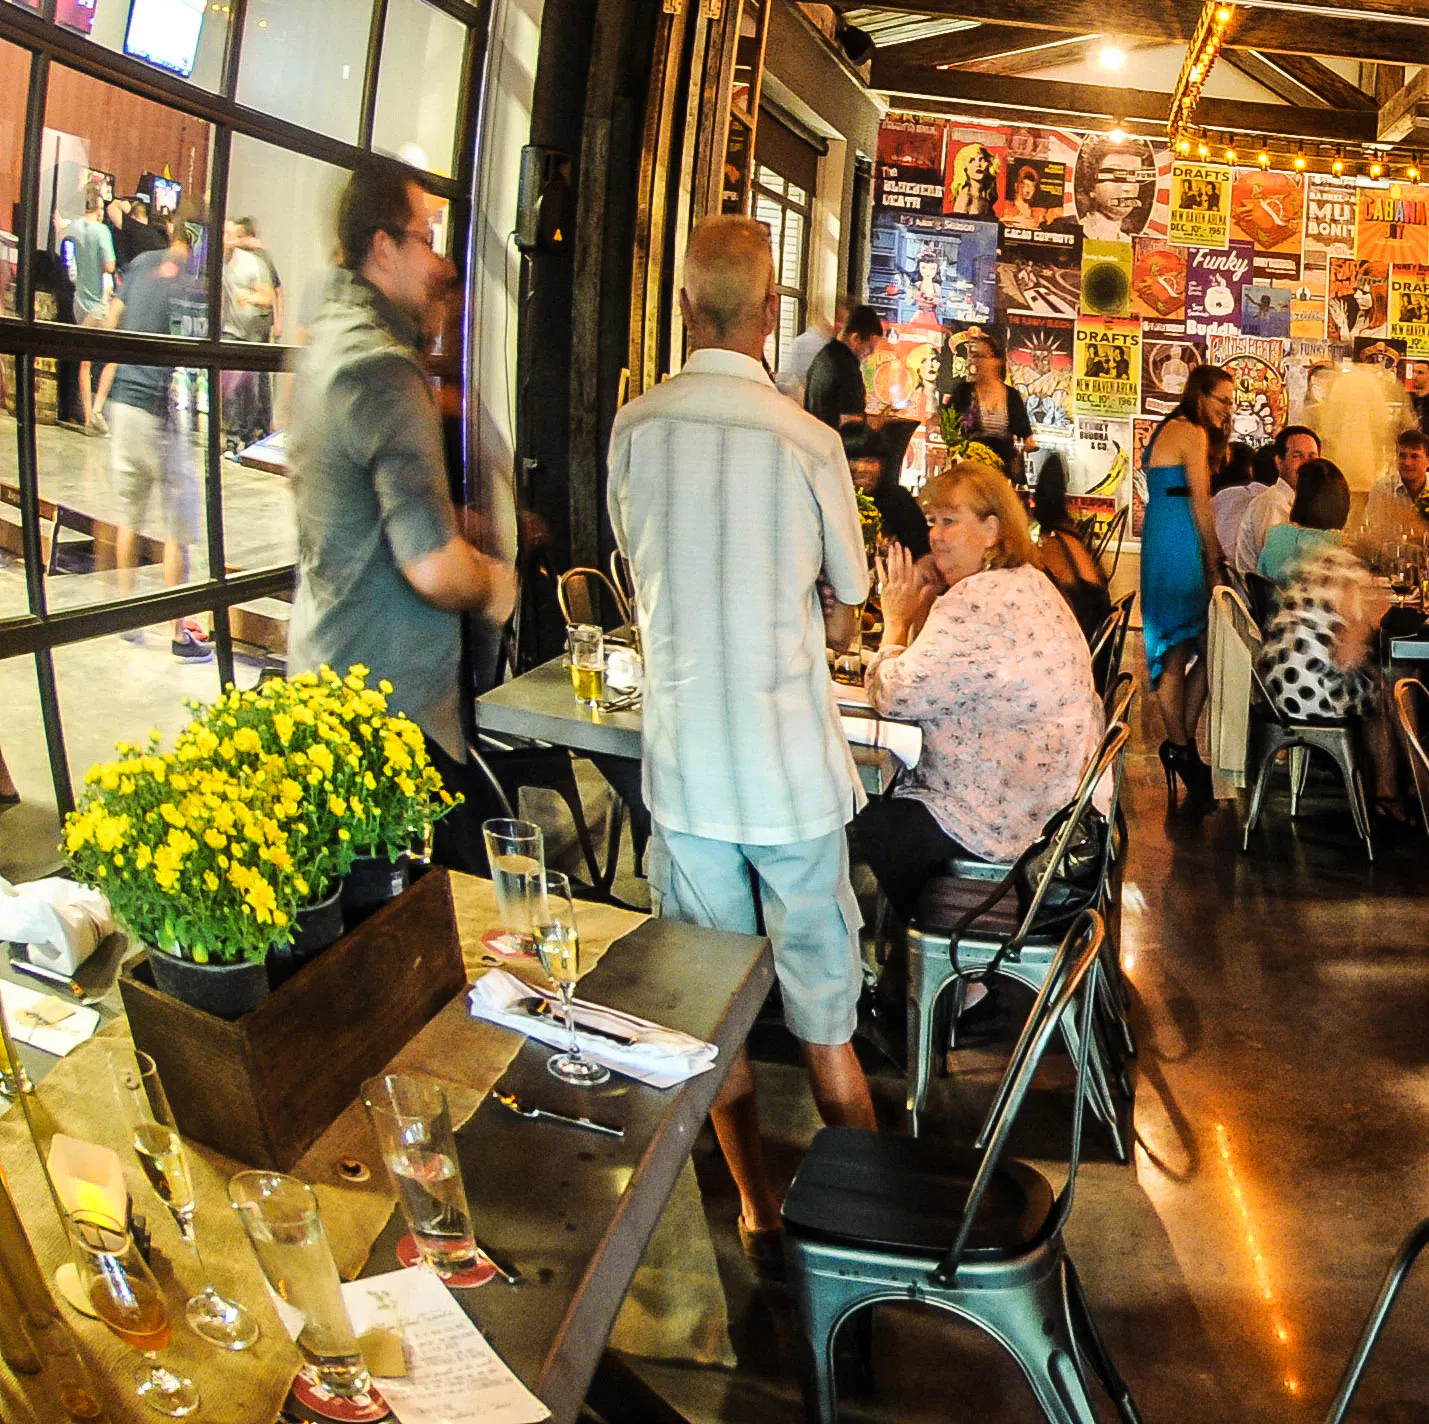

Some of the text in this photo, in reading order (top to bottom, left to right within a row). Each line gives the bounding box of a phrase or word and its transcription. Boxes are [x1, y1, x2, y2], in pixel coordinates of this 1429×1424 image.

[1173, 168, 1230, 181] DRAFTS
[1364, 197, 1427, 225] CABANA
[1193, 249, 1249, 281] Funky
[1186, 319, 1242, 335] Buddh
[1076, 330, 1139, 345] DRAFTS
